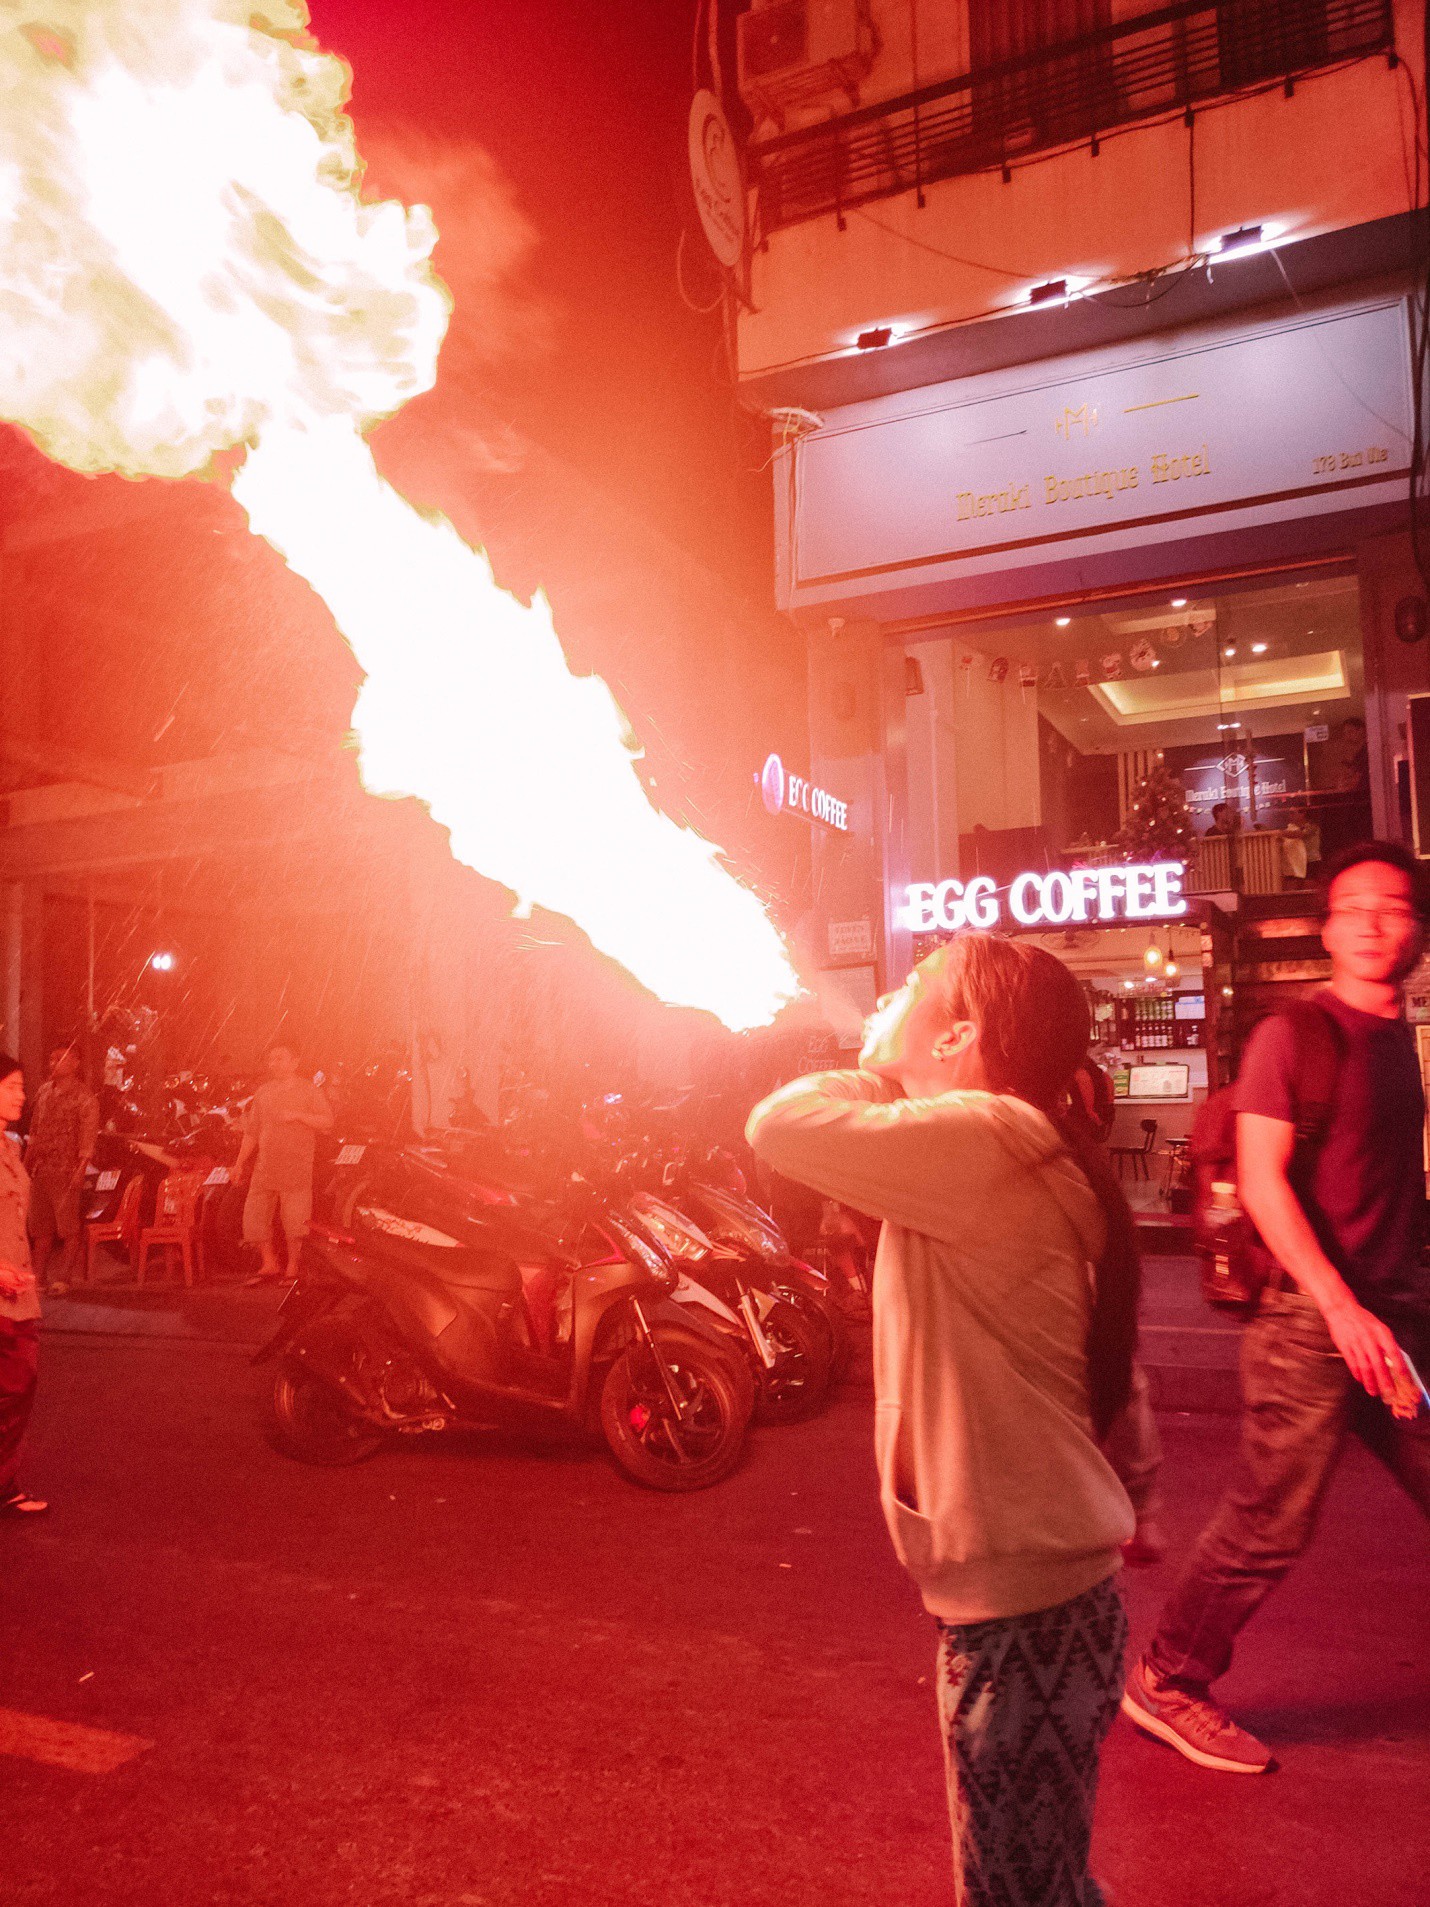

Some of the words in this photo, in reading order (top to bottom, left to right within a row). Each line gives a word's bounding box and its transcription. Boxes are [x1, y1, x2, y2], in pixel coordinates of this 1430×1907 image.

[956, 482, 1031, 521] Meraki
[1044, 466, 1139, 505] Boutique
[1151, 443, 1211, 485] Hotel
[811, 786, 848, 831] COFFEE
[904, 876, 999, 932] EGG
[1009, 862, 1187, 924] COFFEE
